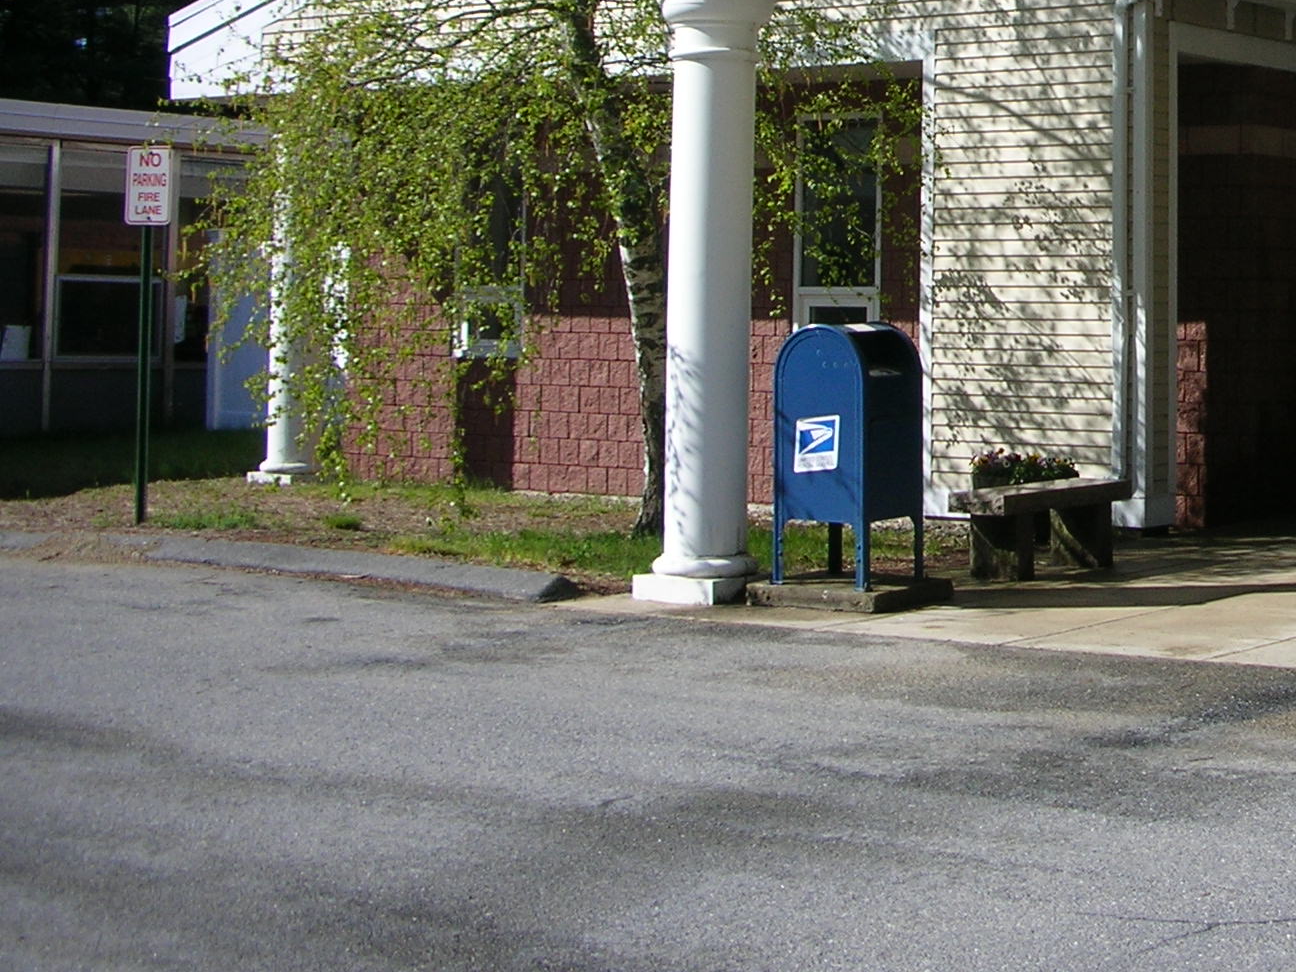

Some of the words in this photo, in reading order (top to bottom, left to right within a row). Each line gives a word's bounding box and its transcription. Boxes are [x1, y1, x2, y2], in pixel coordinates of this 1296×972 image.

[139, 152, 161, 167] NO
[133, 173, 167, 186] PARKING
[138, 192, 160, 202] FIRE
[135, 205, 162, 215] LANE
